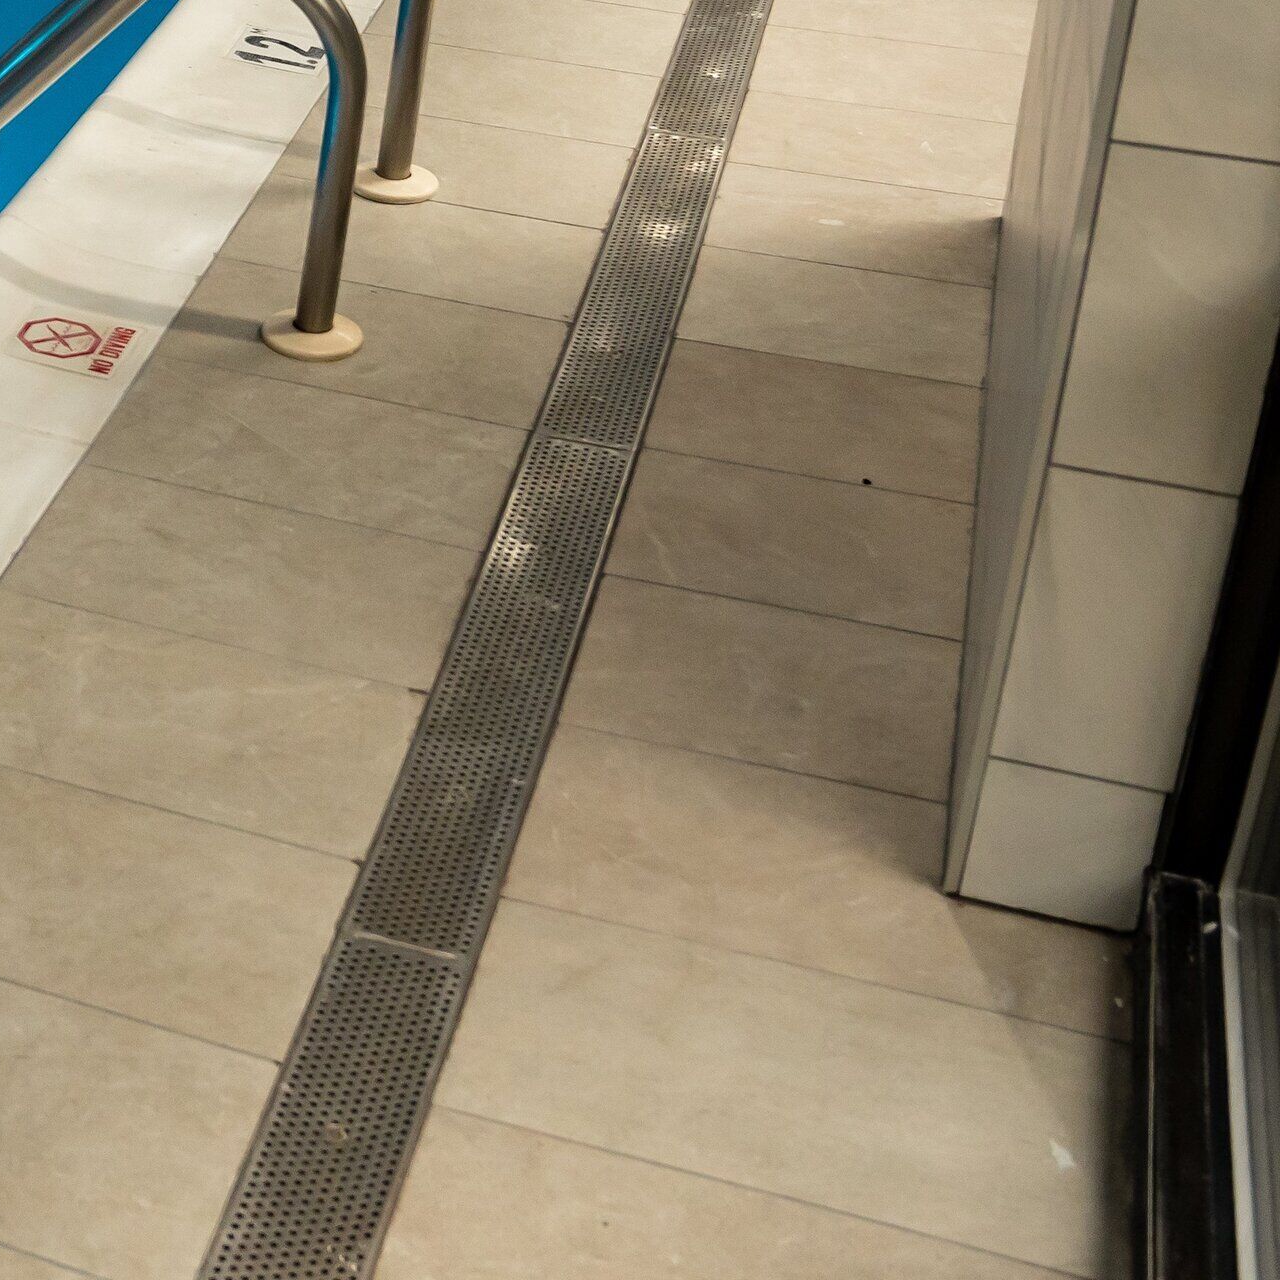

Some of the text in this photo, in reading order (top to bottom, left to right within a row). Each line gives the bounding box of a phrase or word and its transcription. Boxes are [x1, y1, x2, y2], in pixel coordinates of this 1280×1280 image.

[234, 35, 326, 70] 1.2
[87, 326, 136, 375] NO DIVING
